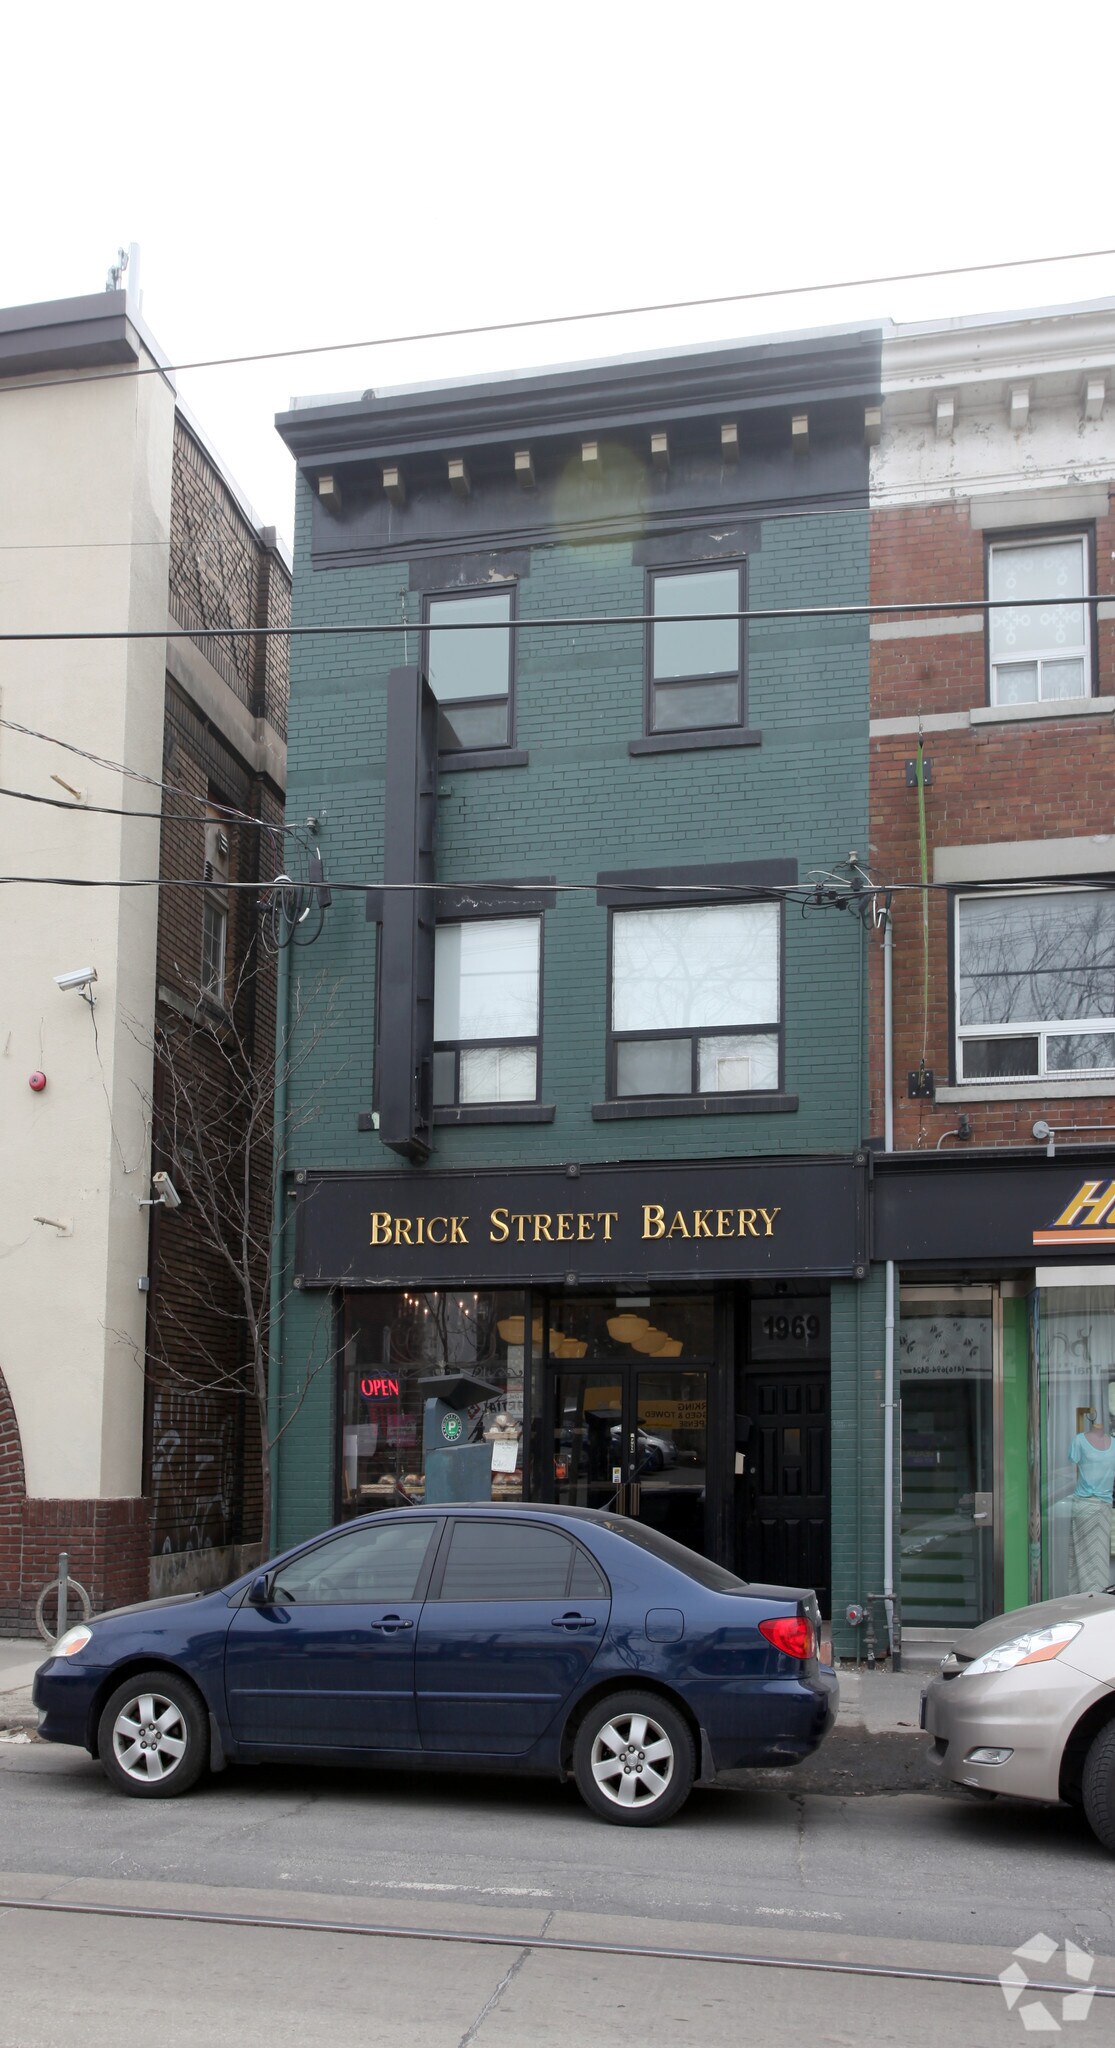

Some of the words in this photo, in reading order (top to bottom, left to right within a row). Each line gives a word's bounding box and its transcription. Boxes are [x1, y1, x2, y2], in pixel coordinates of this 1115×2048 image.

[1053, 1180, 1115, 1226] H
[369, 1211, 470, 1246] BRICK
[489, 1208, 619, 1244] STREET
[641, 1204, 782, 1239] BAKERY
[764, 1314, 820, 1340] 1969
[360, 1378, 399, 1397] OPEN
